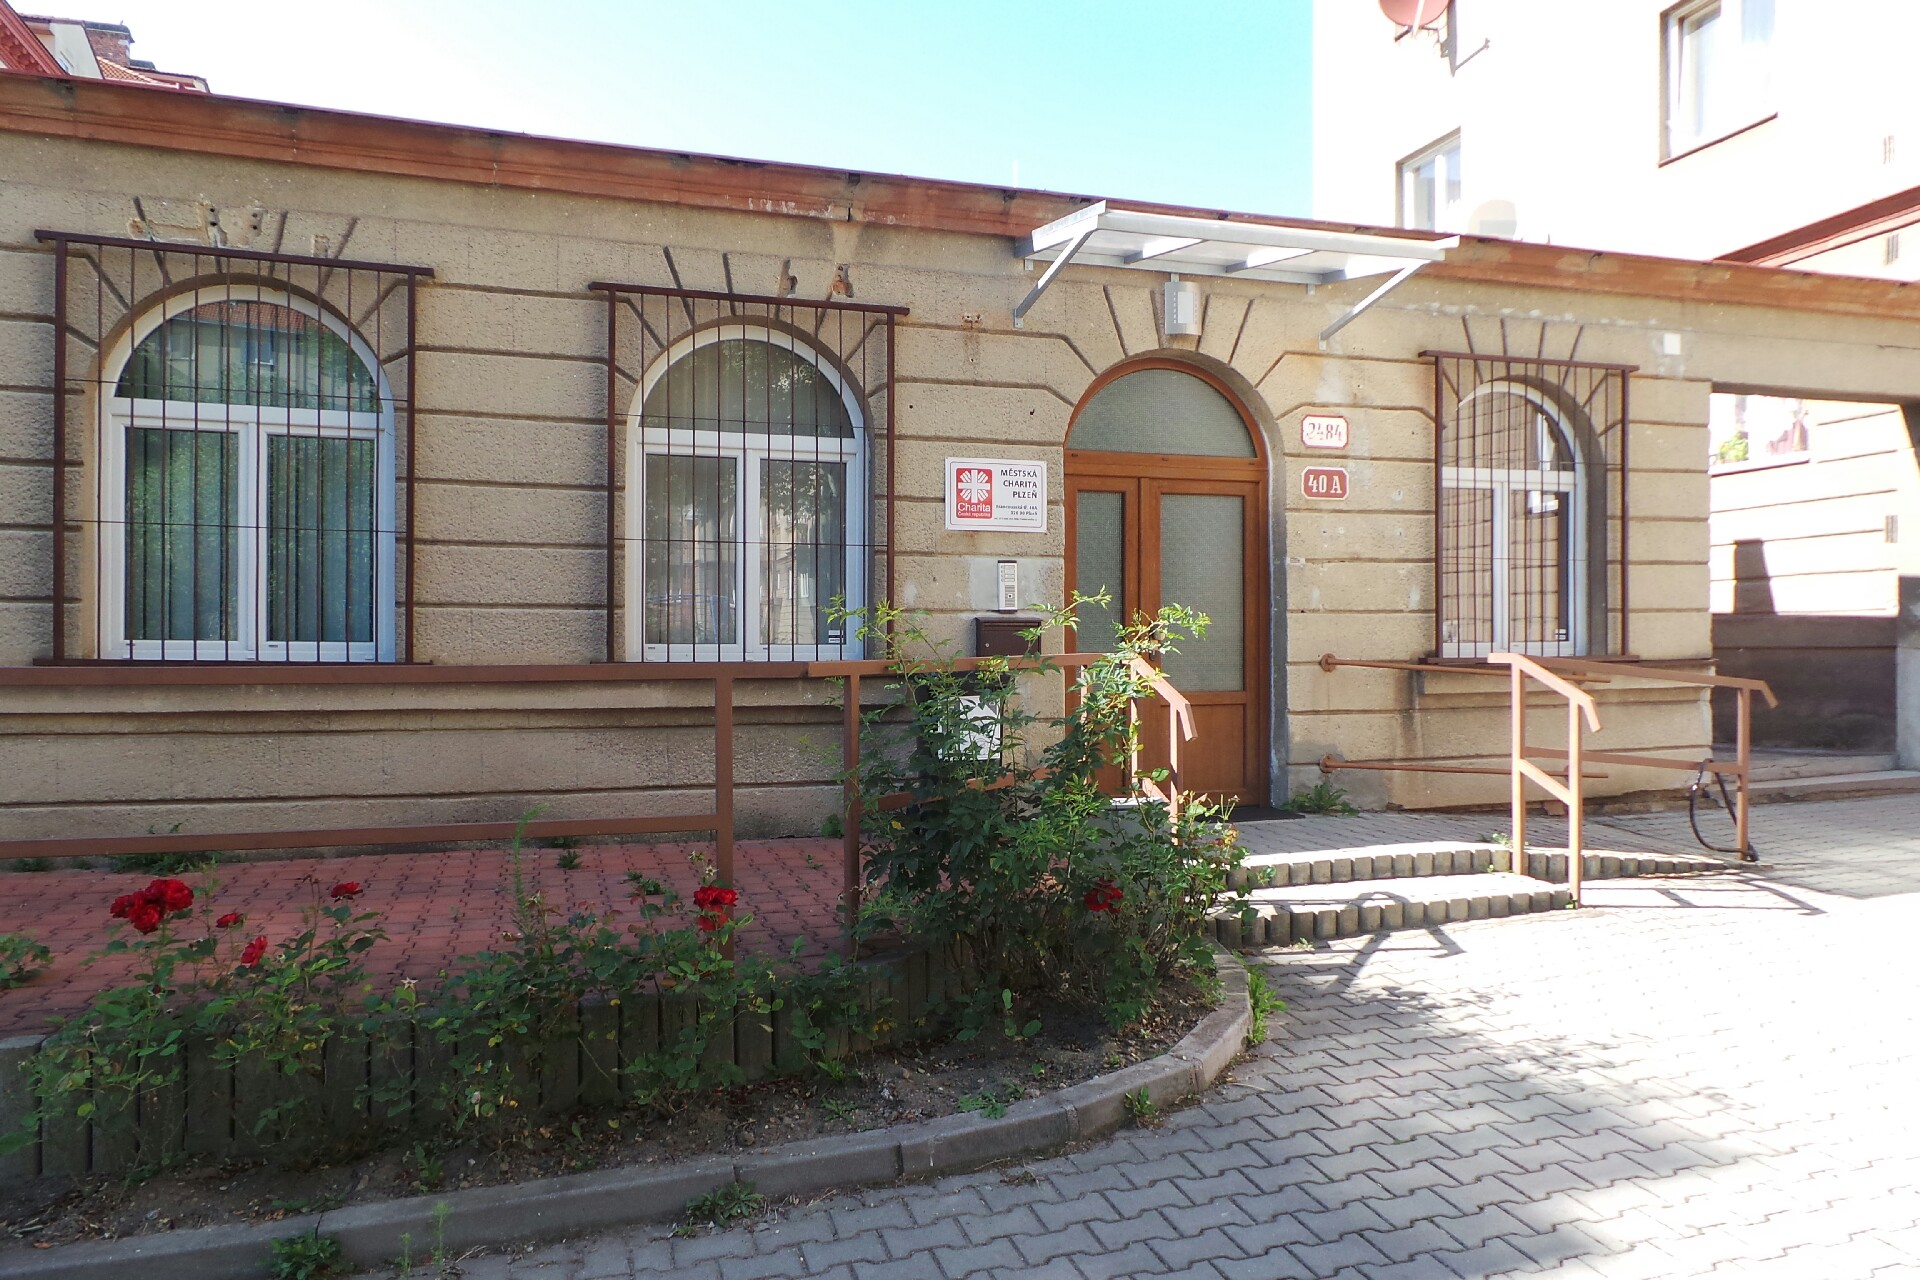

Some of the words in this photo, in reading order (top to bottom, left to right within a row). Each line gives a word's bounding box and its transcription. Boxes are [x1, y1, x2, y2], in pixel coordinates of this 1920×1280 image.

[1306, 422, 1342, 441] 2484
[1000, 468, 1037, 478] MĚSTSKÁ
[1003, 479, 1037, 488] CHARITA
[1308, 474, 1327, 493] 40
[1330, 475, 1342, 494] A
[1013, 490, 1037, 499] PLZEŇ
[958, 502, 991, 512] Charita
